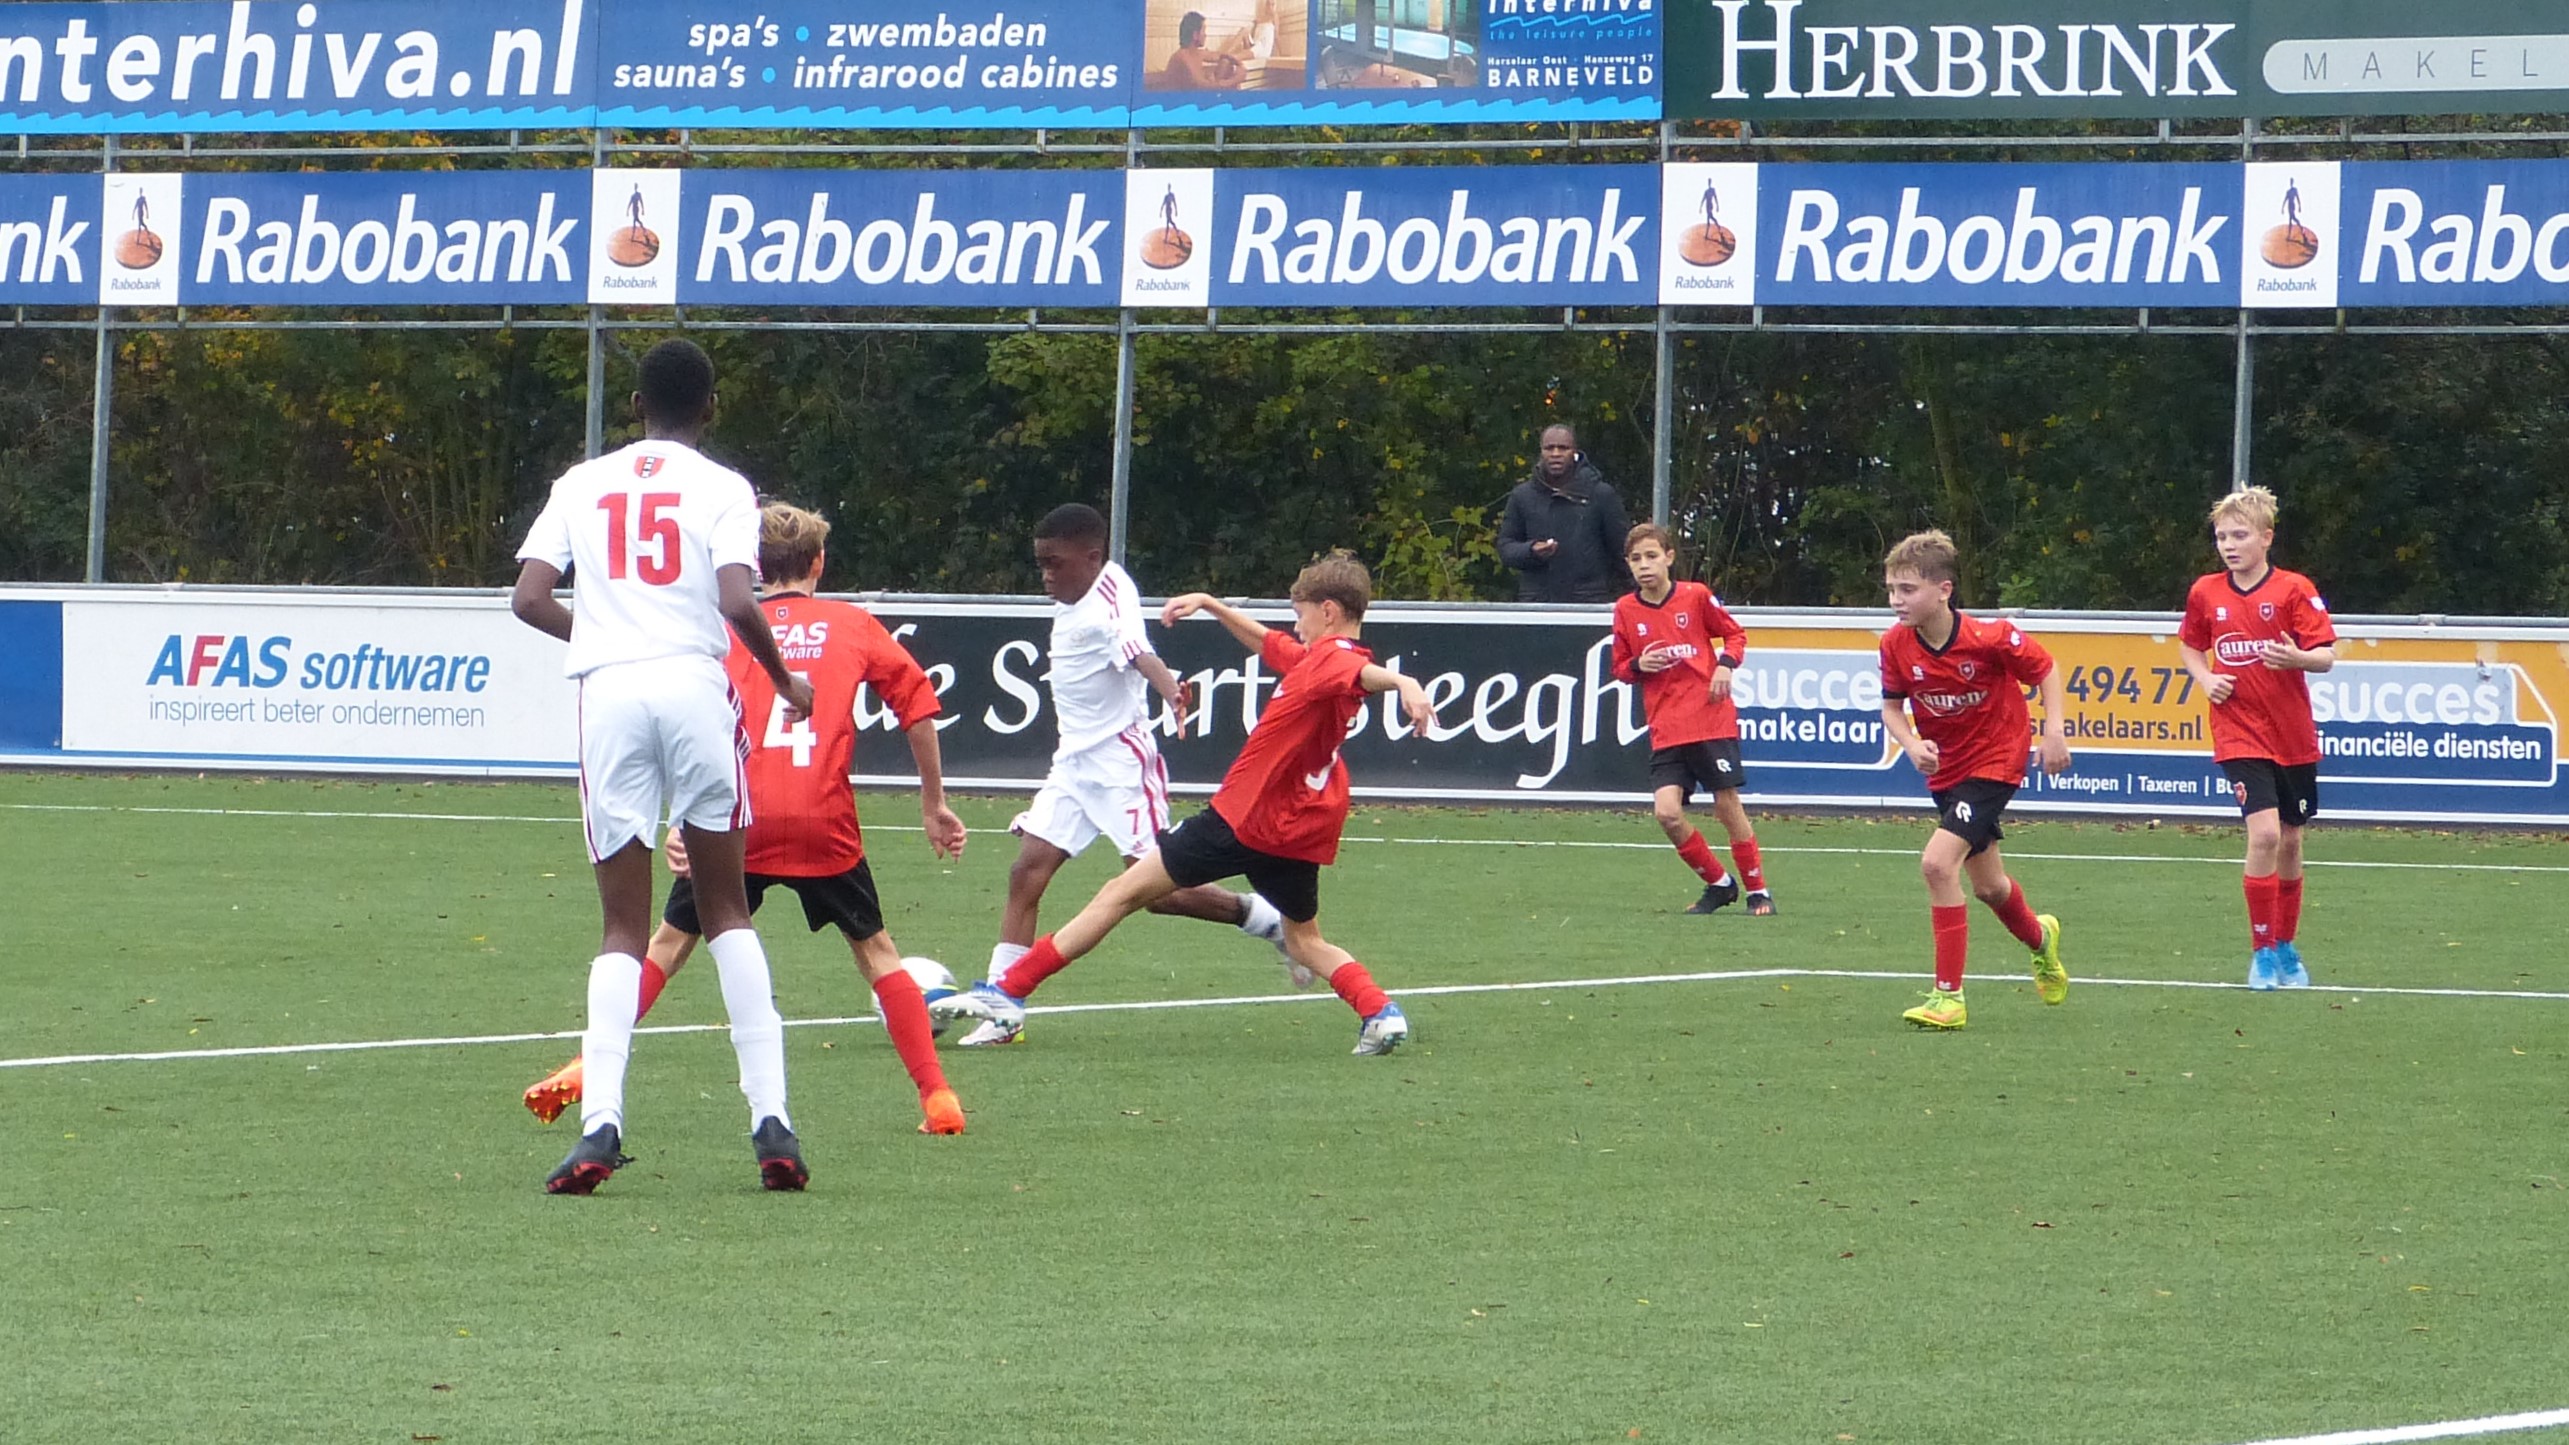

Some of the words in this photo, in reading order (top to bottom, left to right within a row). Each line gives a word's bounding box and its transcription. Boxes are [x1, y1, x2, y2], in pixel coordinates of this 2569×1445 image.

[689, 15, 779, 54] spa's
[827, 13, 1046, 47] zwembaden
[1526, 29, 1585, 40] leisure
[1596, 26, 1652, 40] people
[0, 0, 582, 101] nterhiva.nl
[1488, 57, 1537, 65] Harselaar
[1543, 56, 1567, 65] Oost
[1584, 55, 1635, 65] Hanzeweg
[1641, 54, 1653, 62] 17
[1711, 0, 2238, 99] HERBRINK
[2303, 49, 2539, 80] MAKEL
[614, 56, 745, 89] sauna's
[794, 55, 965, 89] infrarood
[981, 55, 1117, 89] cabines
[1488, 66, 1653, 87] BARNEVELD
[196, 192, 578, 284] Rabobank
[695, 192, 1110, 285] Rabobank
[1228, 189, 1646, 284] Rabobank
[1775, 187, 2229, 284] Rabobank
[2359, 185, 2569, 284] Rabo
[110, 277, 161, 291] Rabobank
[603, 275, 657, 289] Rabobank
[1136, 277, 1190, 291] Rabobank
[1675, 275, 1734, 290] Rabobank
[2257, 278, 2317, 292] Rabobank
[597, 492, 681, 585] 15
[771, 622, 828, 647] FAS
[146, 634, 291, 688] AFAS
[300, 642, 490, 693] software
[779, 646, 822, 659] tware
[1731, 669, 1882, 711] succe
[2066, 666, 2140, 703] 494
[2151, 668, 2194, 704] 77
[149, 695, 255, 727] inspireert
[264, 695, 324, 724] beter
[332, 699, 485, 727] ondernemen
[763, 671, 816, 767] 4
[2310, 681, 2501, 725] succes
[1737, 712, 1881, 743] makelaar
[2316, 730, 2428, 757] inanciële
[2434, 733, 2540, 760] diensten
[2049, 774, 2118, 794] Verkopen
[2138, 776, 2197, 792] Taxeren
[1126, 809, 1139, 835] 7
